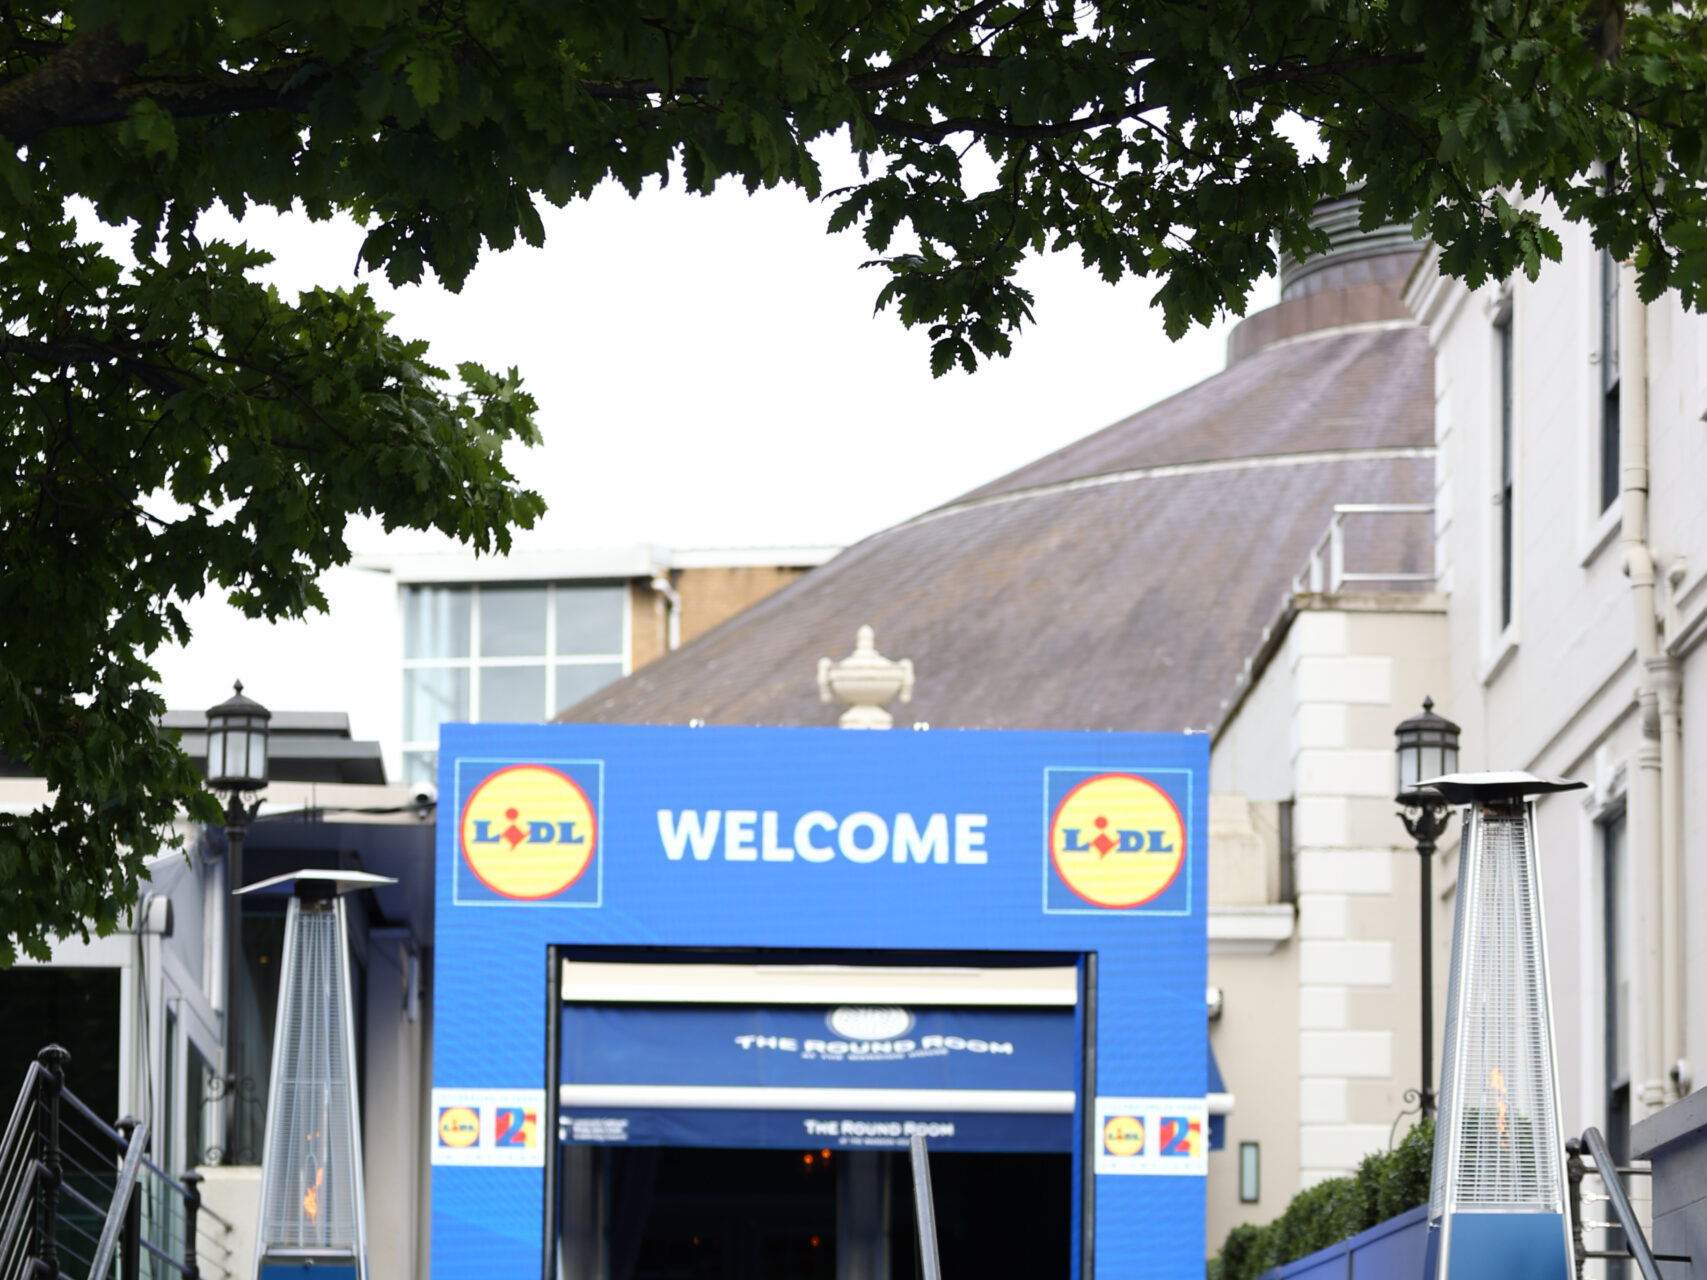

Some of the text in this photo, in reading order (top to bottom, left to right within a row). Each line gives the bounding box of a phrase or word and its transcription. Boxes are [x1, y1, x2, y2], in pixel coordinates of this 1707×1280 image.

[656, 809, 988, 864] WELCOME
[735, 1035, 798, 1051] THE
[803, 1039, 916, 1055] ROUND
[921, 1034, 1013, 1055] ROOM
[804, 1118, 955, 1138] THE ROUND ROOM
